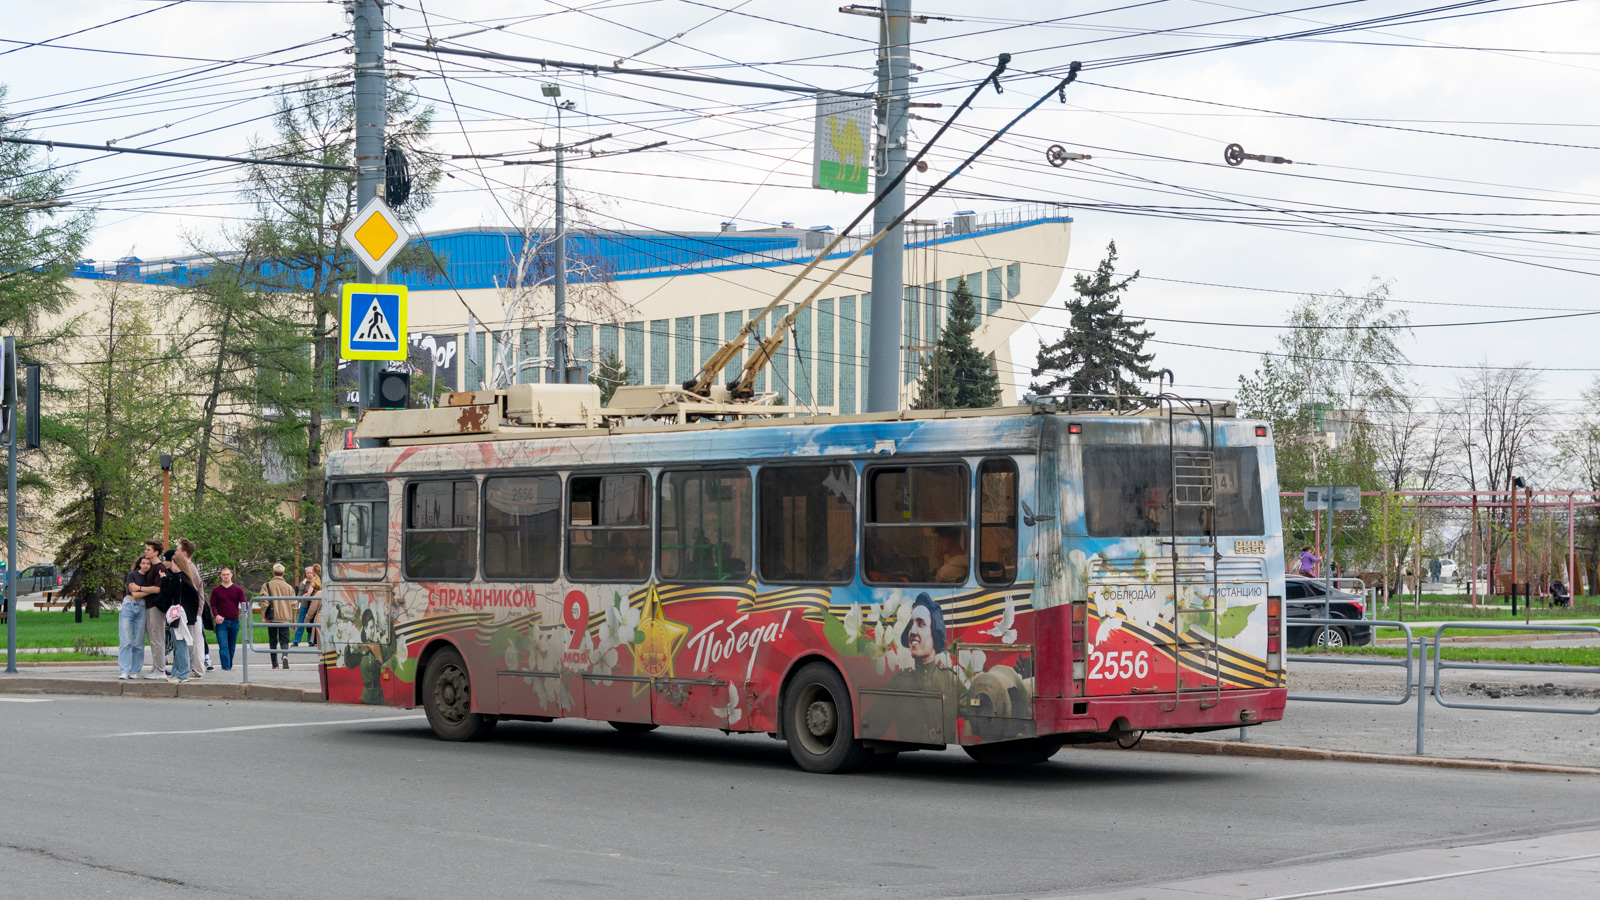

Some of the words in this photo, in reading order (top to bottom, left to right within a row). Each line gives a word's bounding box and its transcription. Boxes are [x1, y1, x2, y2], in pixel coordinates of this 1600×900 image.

[511, 487, 533, 501] 2556
[1234, 546, 1266, 554] 5256
[428, 588, 436, 606] С
[439, 588, 537, 610] ПРАЗДНИКОМ
[1103, 588, 1156, 601] СОБЛЮДАЙ
[1208, 587, 1262, 598] ДИСТАНЦИЮ
[563, 590, 589, 650] 9
[687, 610, 792, 681] Победа!
[1088, 650, 1149, 680] 2556
